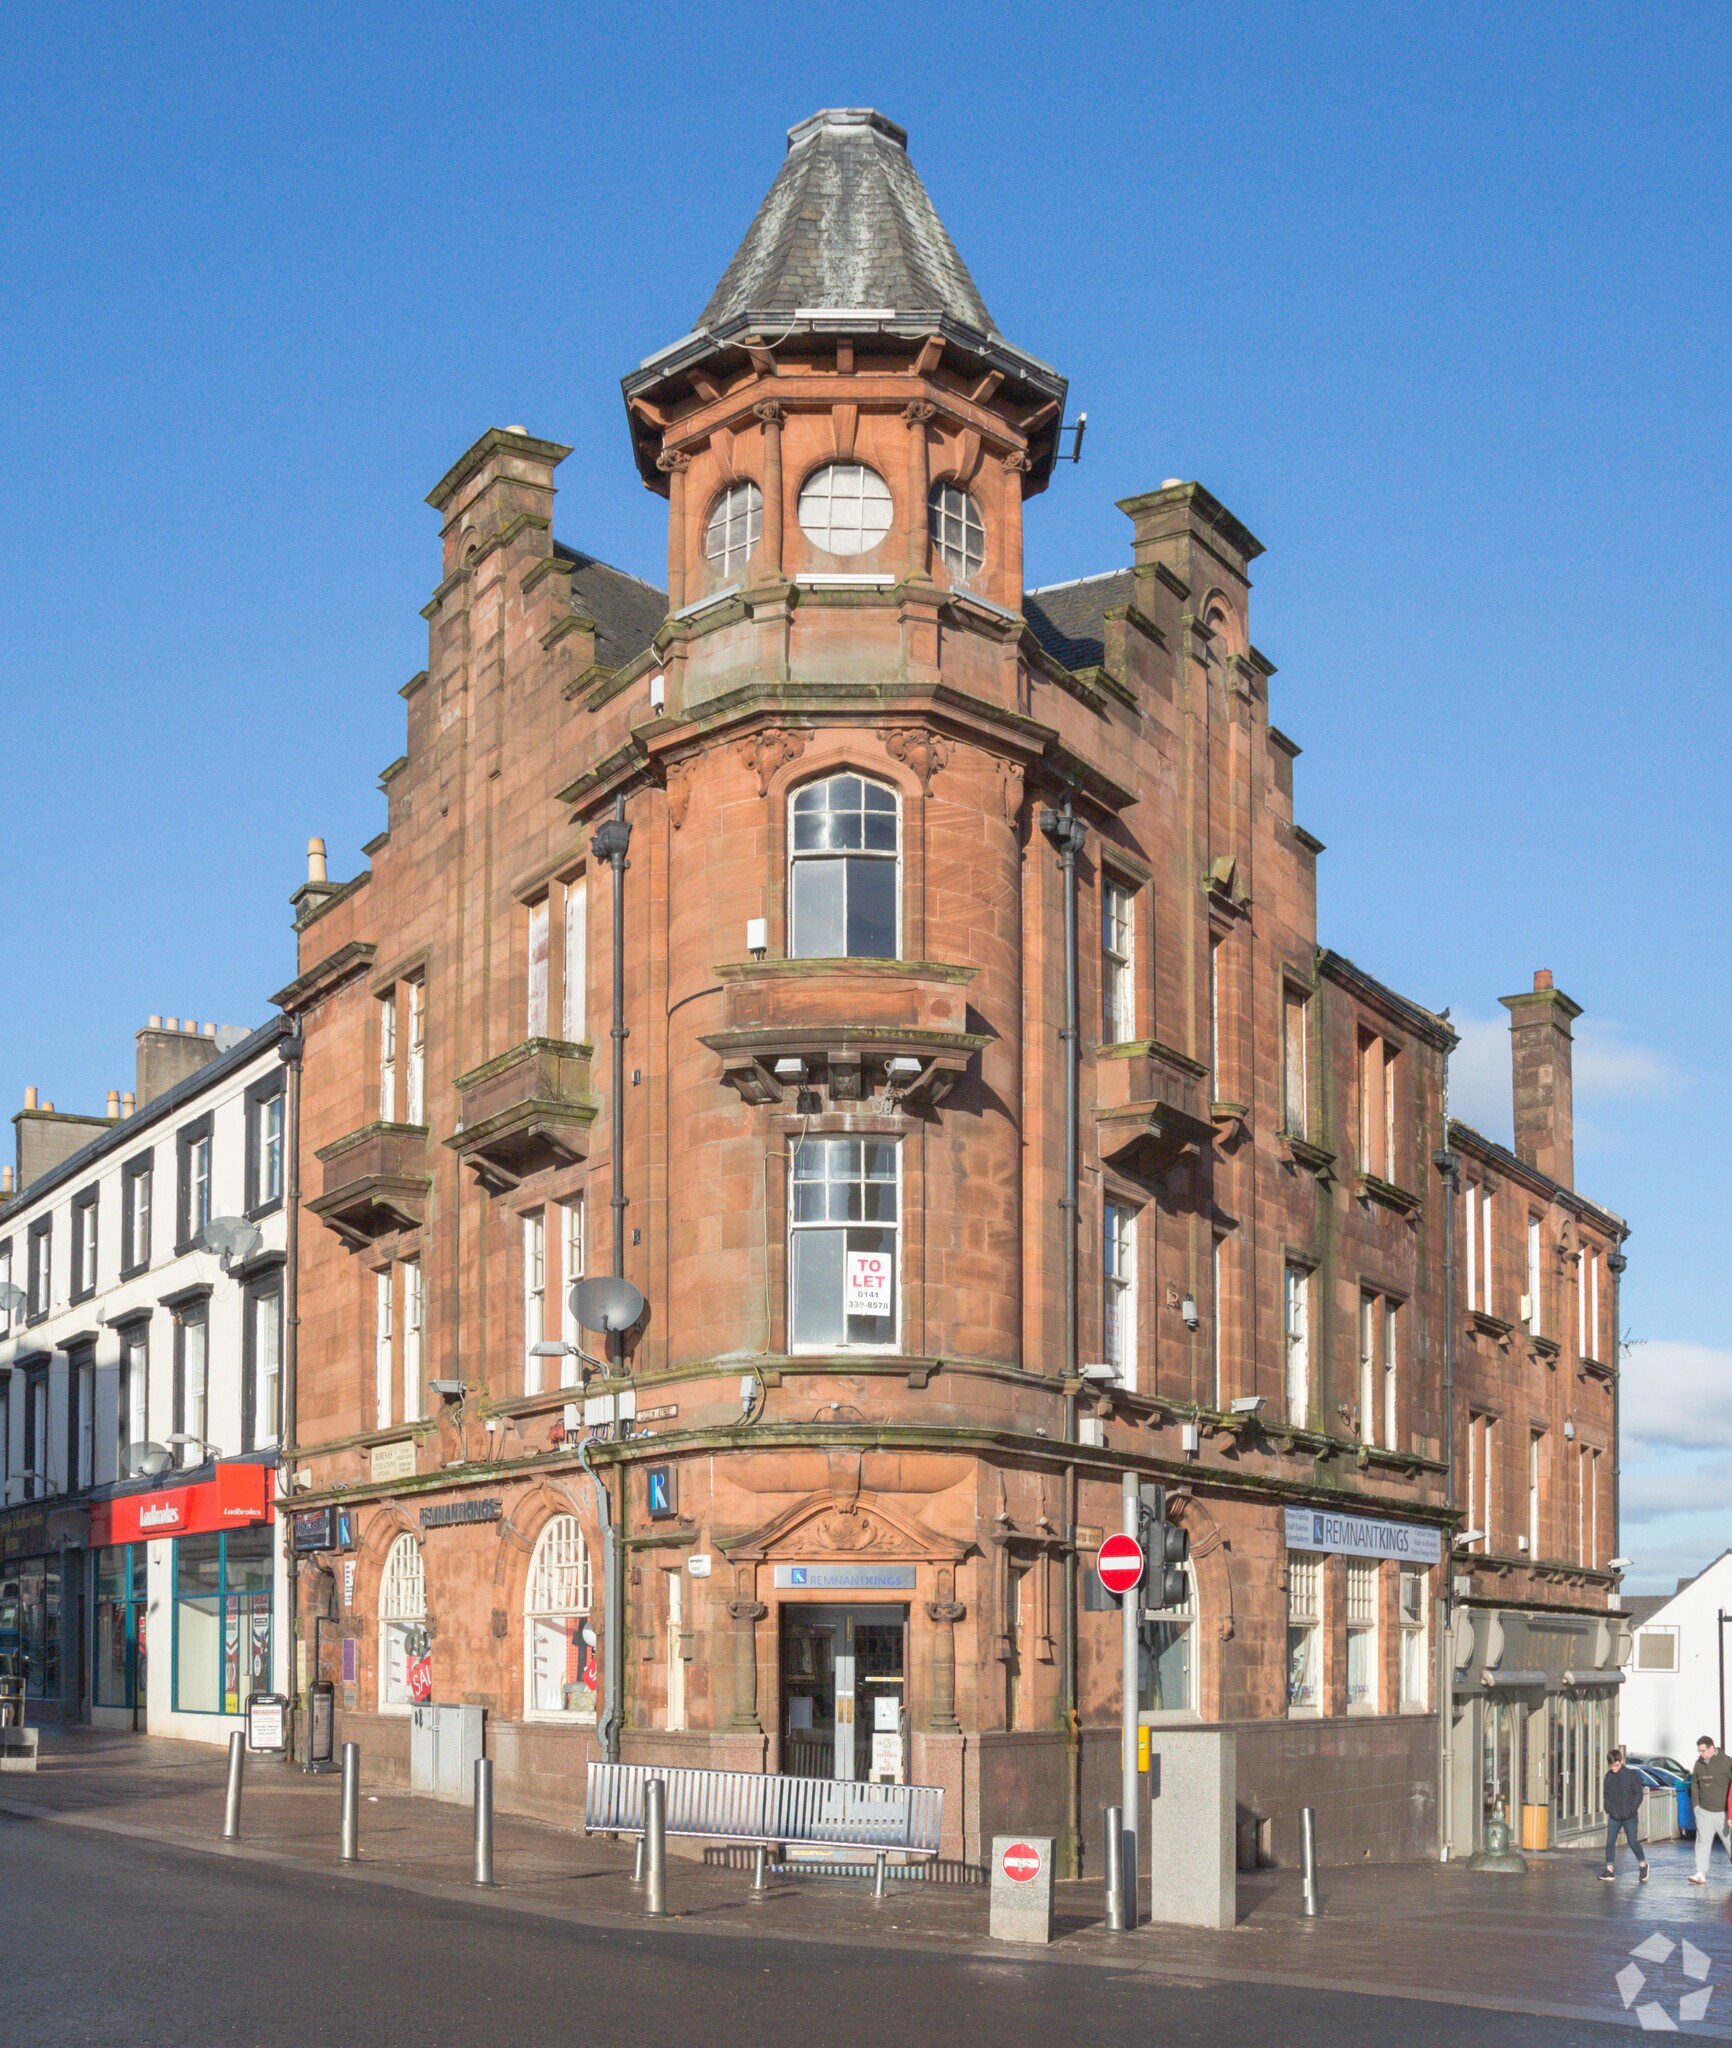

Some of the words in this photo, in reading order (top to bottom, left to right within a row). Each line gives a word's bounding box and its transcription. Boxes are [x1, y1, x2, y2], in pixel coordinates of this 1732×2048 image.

[857, 1259, 881, 1272] TO
[852, 1275, 886, 1288] LET
[140, 1502, 179, 1527] Ladbrokes
[223, 1508, 262, 1516] Ladbrokes
[1325, 1518, 1409, 1553] REMNANTKINGS
[810, 1575, 903, 1586] REMNANTKINGS
[413, 1664, 431, 1695] SAL
